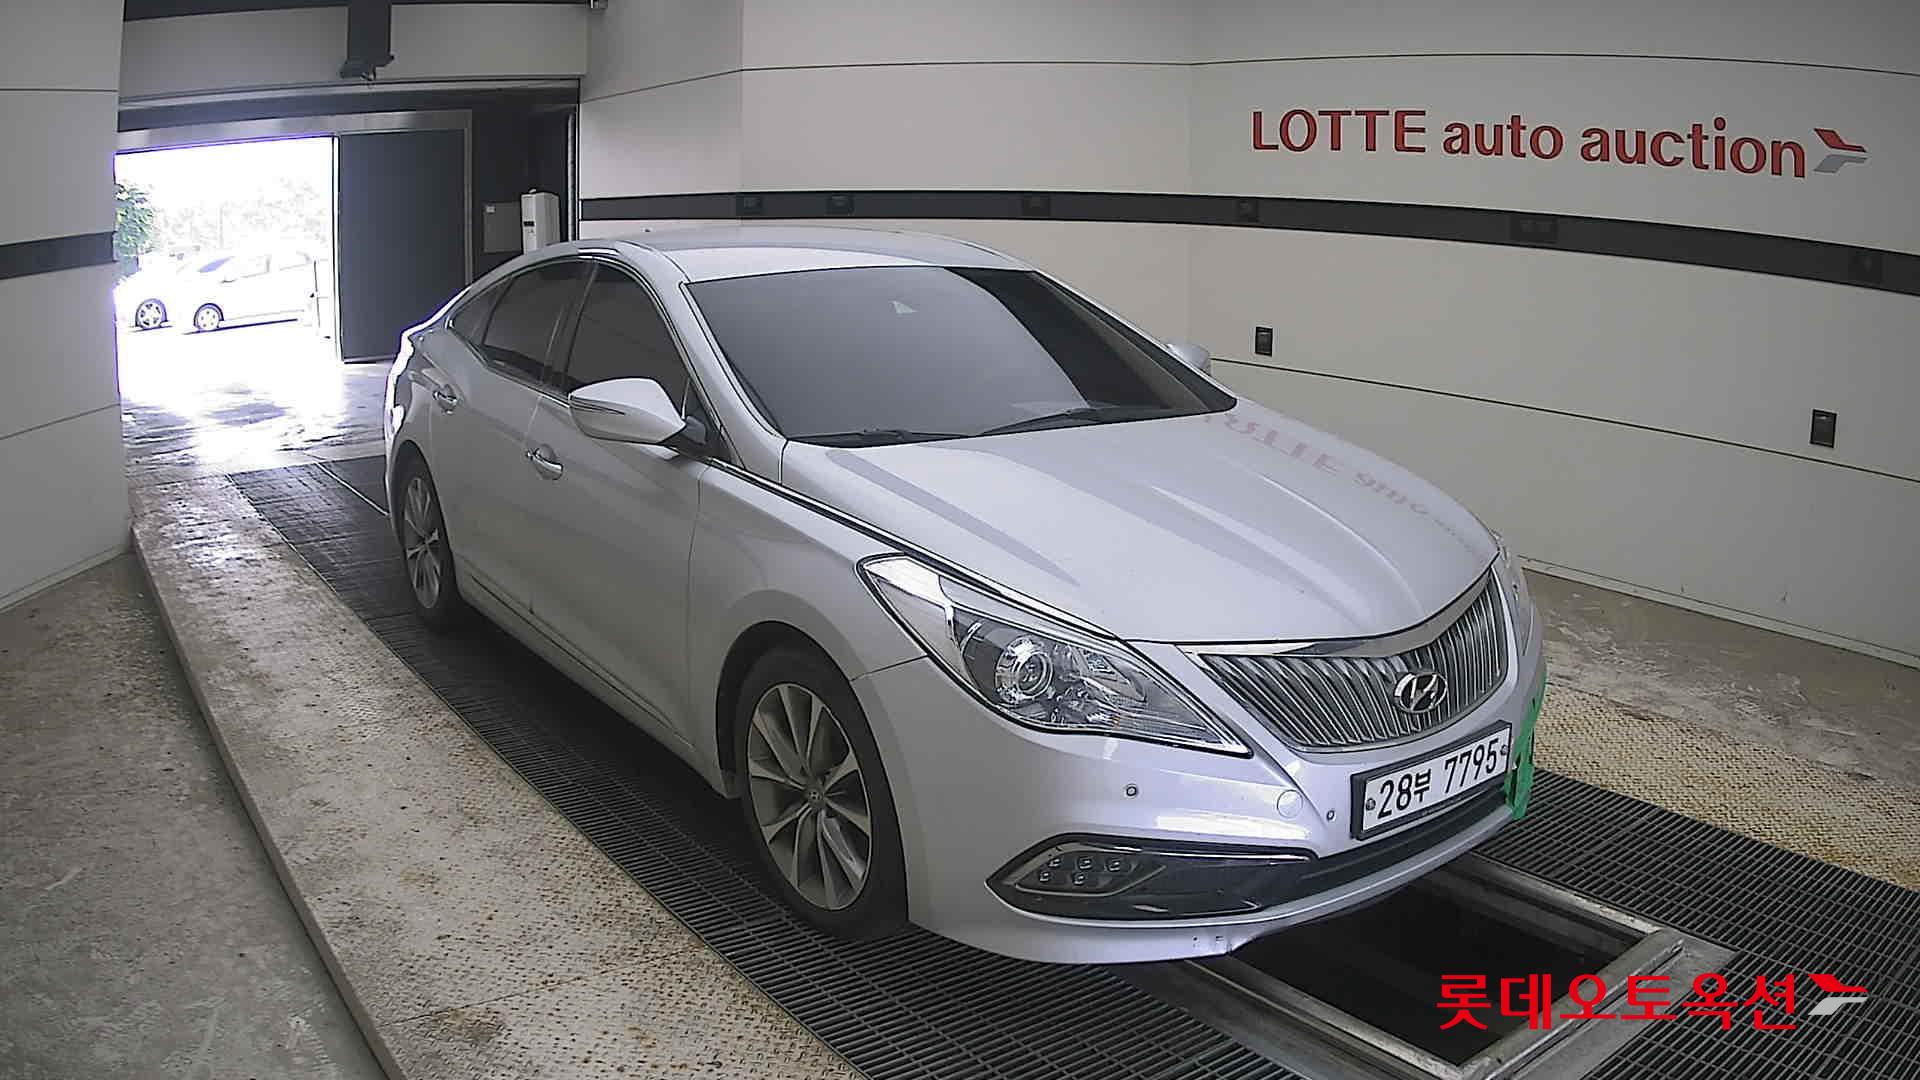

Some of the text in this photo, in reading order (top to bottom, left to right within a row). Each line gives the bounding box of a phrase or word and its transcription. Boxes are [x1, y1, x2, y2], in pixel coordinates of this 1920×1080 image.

[1252, 109, 1807, 179] LOTTE auto auction
[1377, 737, 1499, 819] 28부 7795
